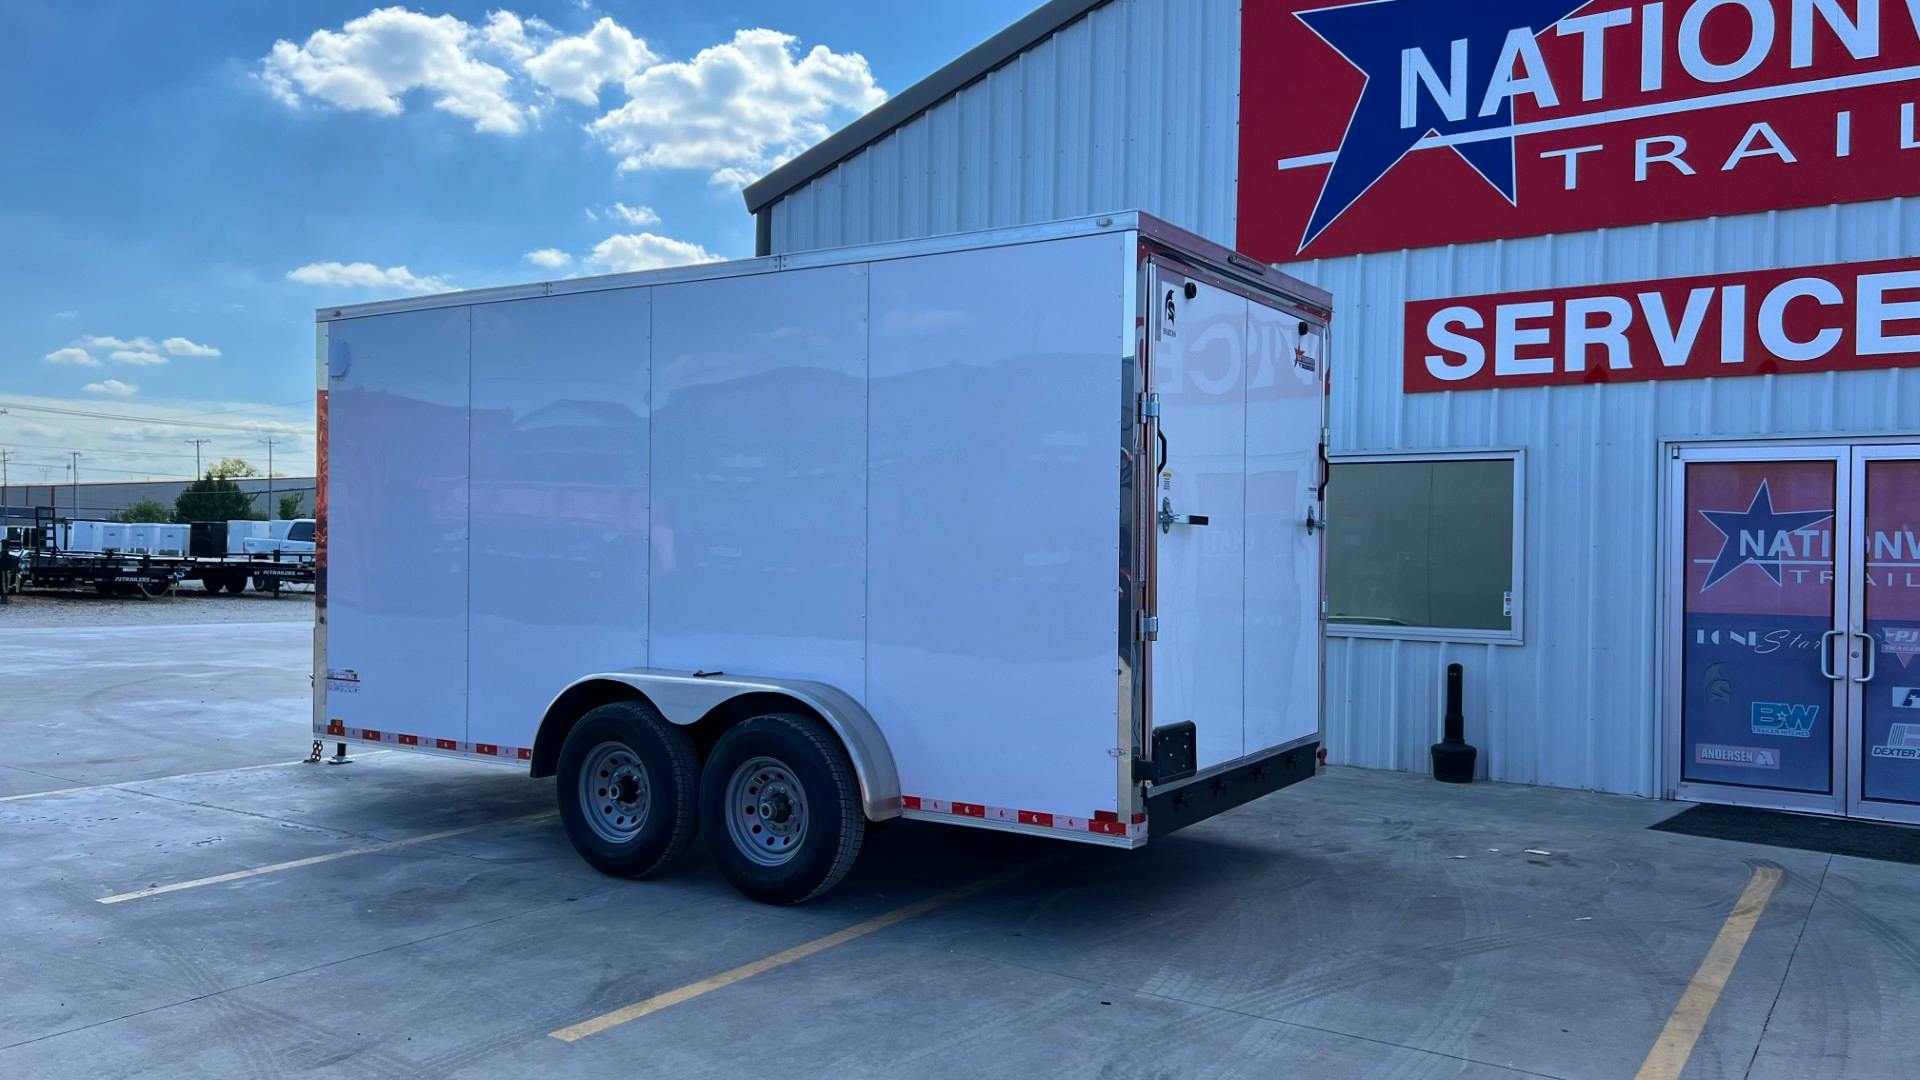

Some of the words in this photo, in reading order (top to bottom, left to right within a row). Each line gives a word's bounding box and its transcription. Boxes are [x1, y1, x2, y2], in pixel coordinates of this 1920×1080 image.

[1401, 0, 1920, 129] NATION
[1425, 272, 1920, 381] SERVICE
[1894, 630, 1919, 643] PJ
[1701, 748, 1753, 762] ANDERSEN
[1873, 747, 1916, 758] DEXTER
